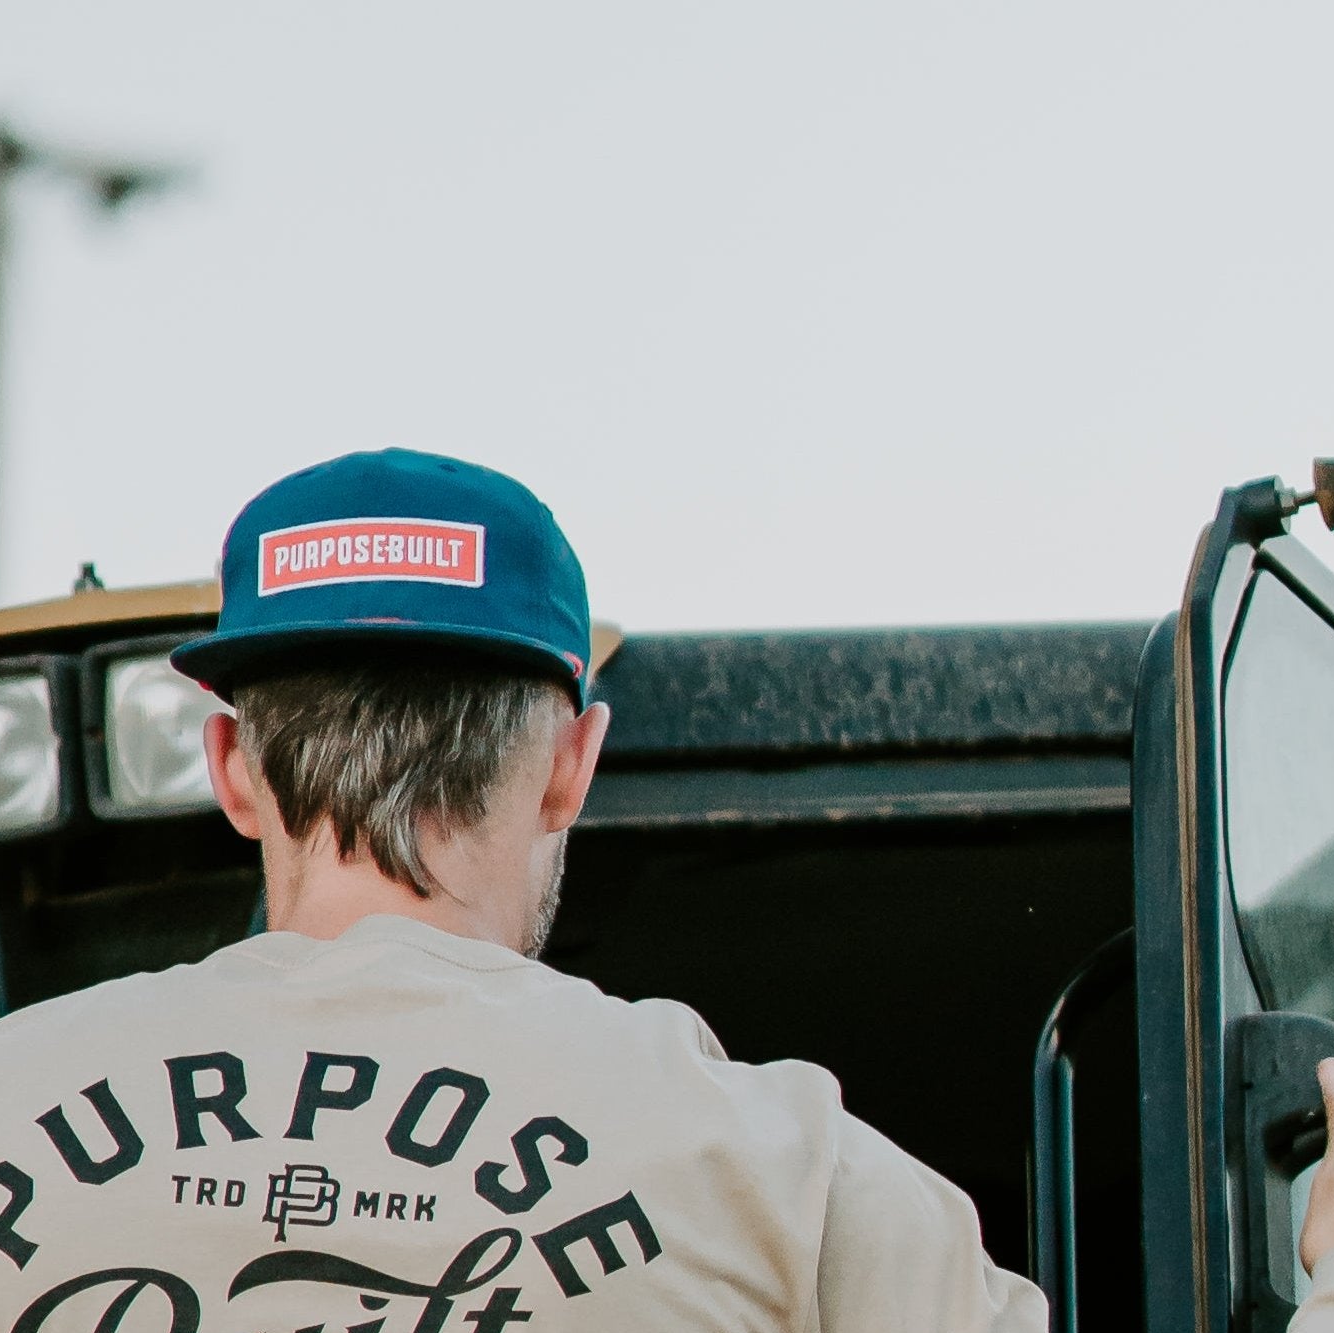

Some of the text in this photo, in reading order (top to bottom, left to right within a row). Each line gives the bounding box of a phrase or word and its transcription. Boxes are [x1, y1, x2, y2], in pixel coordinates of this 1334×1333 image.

[274, 534, 464, 576] PURPOSEBUILT
[172, 1174, 246, 1208] TRD
[354, 1190, 437, 1222] MRK
